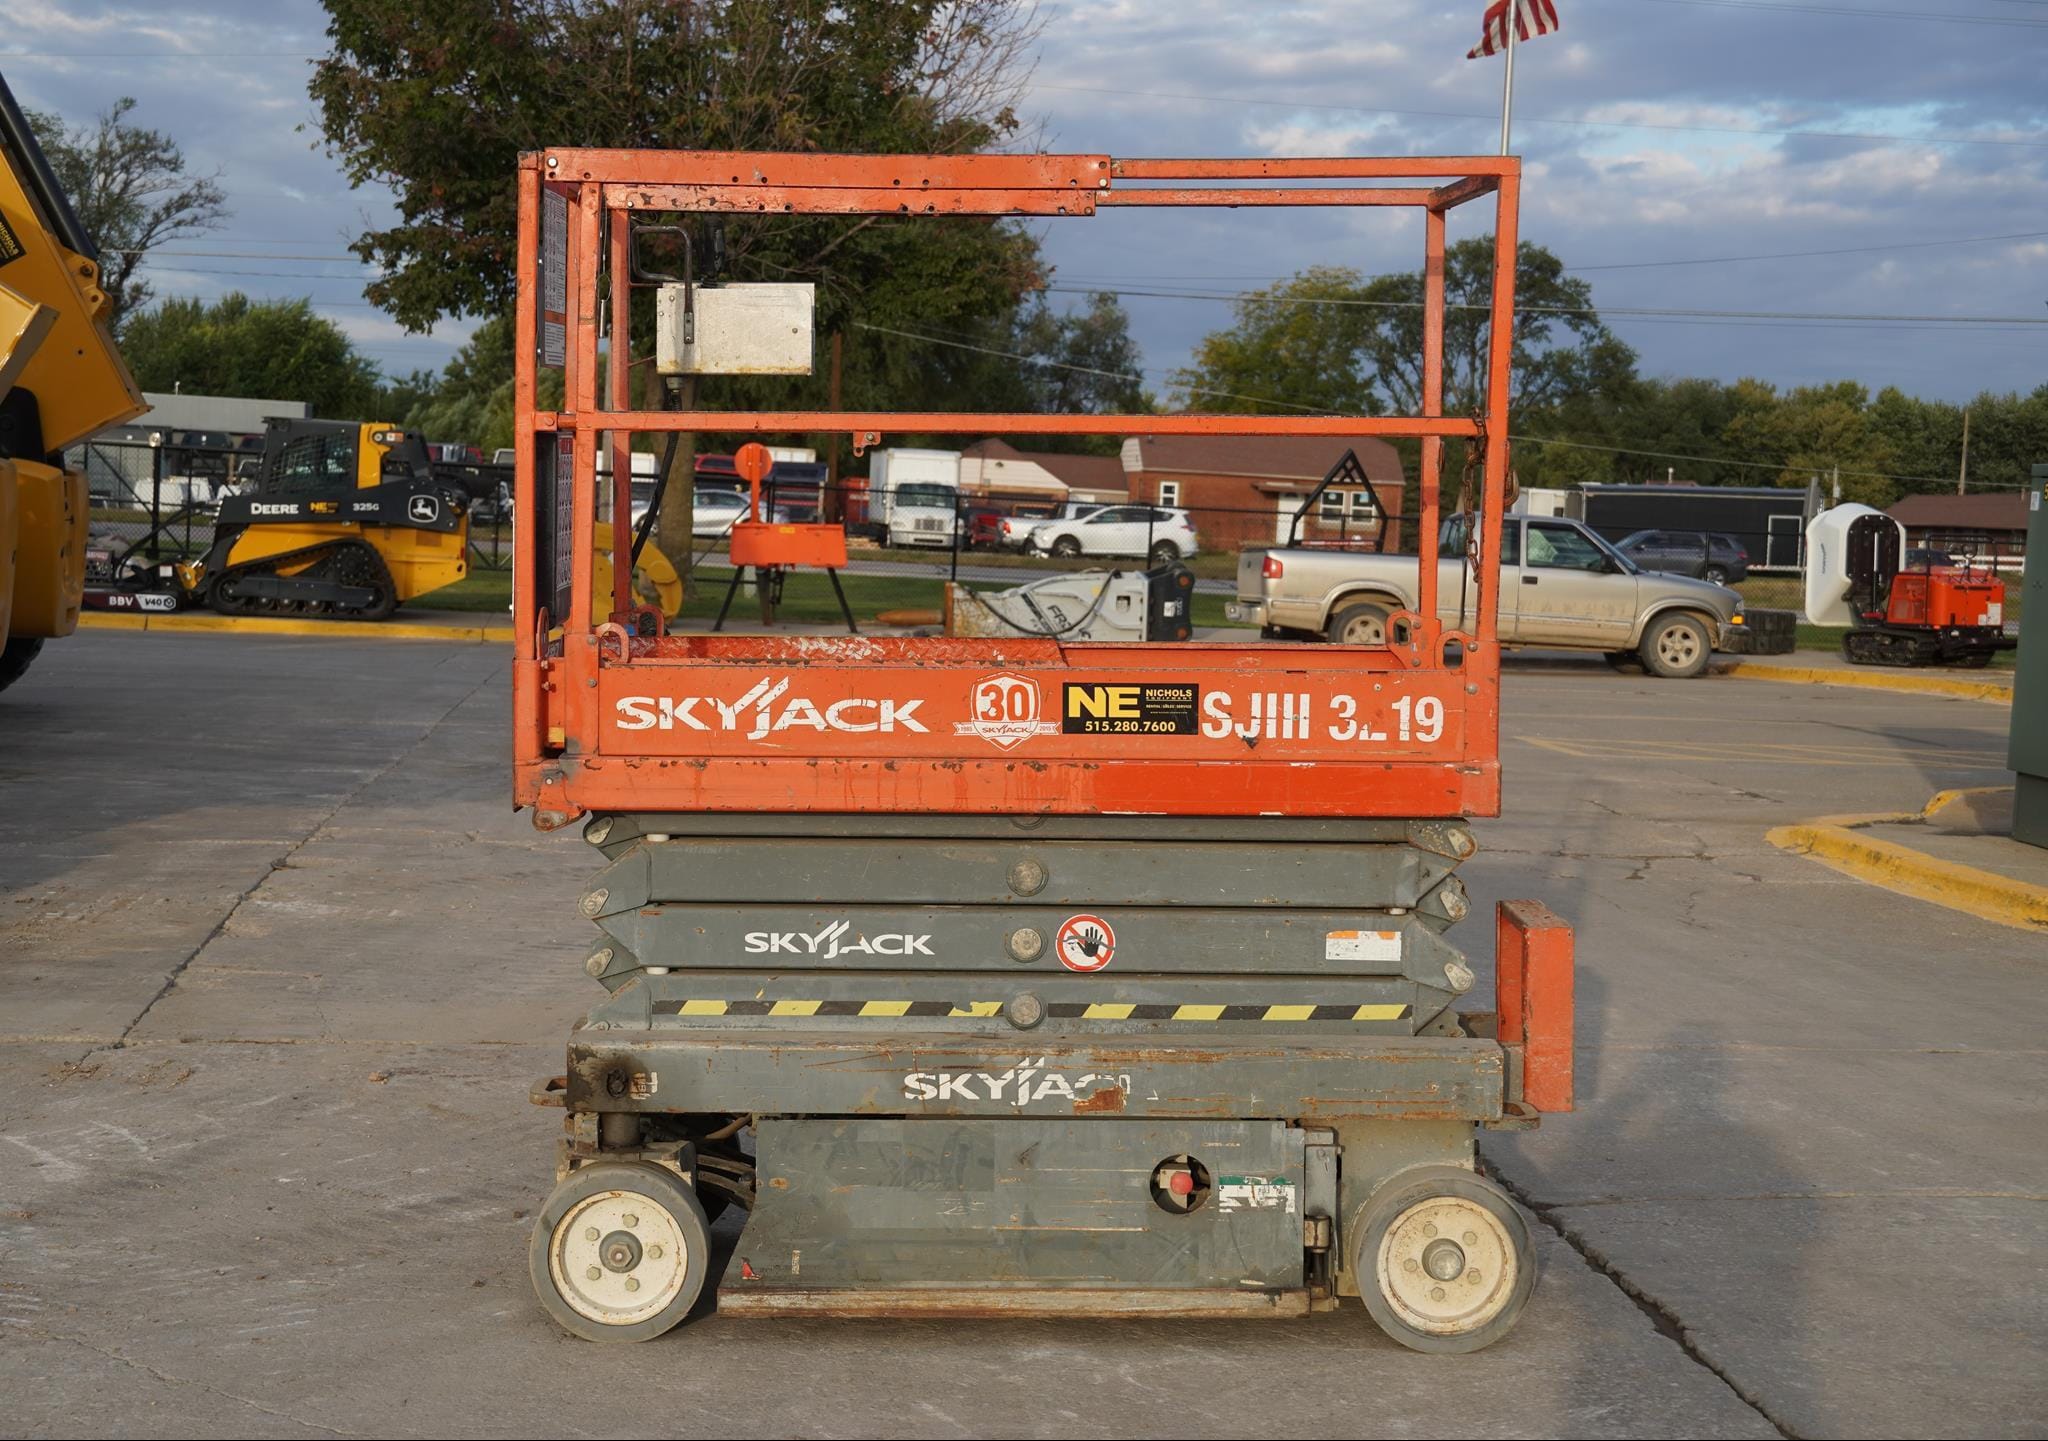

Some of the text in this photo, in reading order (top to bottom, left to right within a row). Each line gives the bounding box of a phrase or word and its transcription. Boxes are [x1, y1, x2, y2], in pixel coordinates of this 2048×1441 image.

[251, 503, 299, 515] DEERE
[310, 502, 327, 511] NE
[353, 503, 379, 511] 325G
[145, 598, 162, 607] V40
[616, 676, 930, 740] SKYJACK
[981, 684, 1029, 721] 30
[1068, 687, 1140, 717] NE
[1146, 689, 1193, 697] NICHOLS
[982, 724, 1030, 734] SKYJACK
[1085, 721, 1176, 732] 515.280.7600
[1202, 691, 1310, 739] SJIII
[744, 920, 935, 959] SKYJACK
[904, 1056, 1131, 1106] SKYJA
